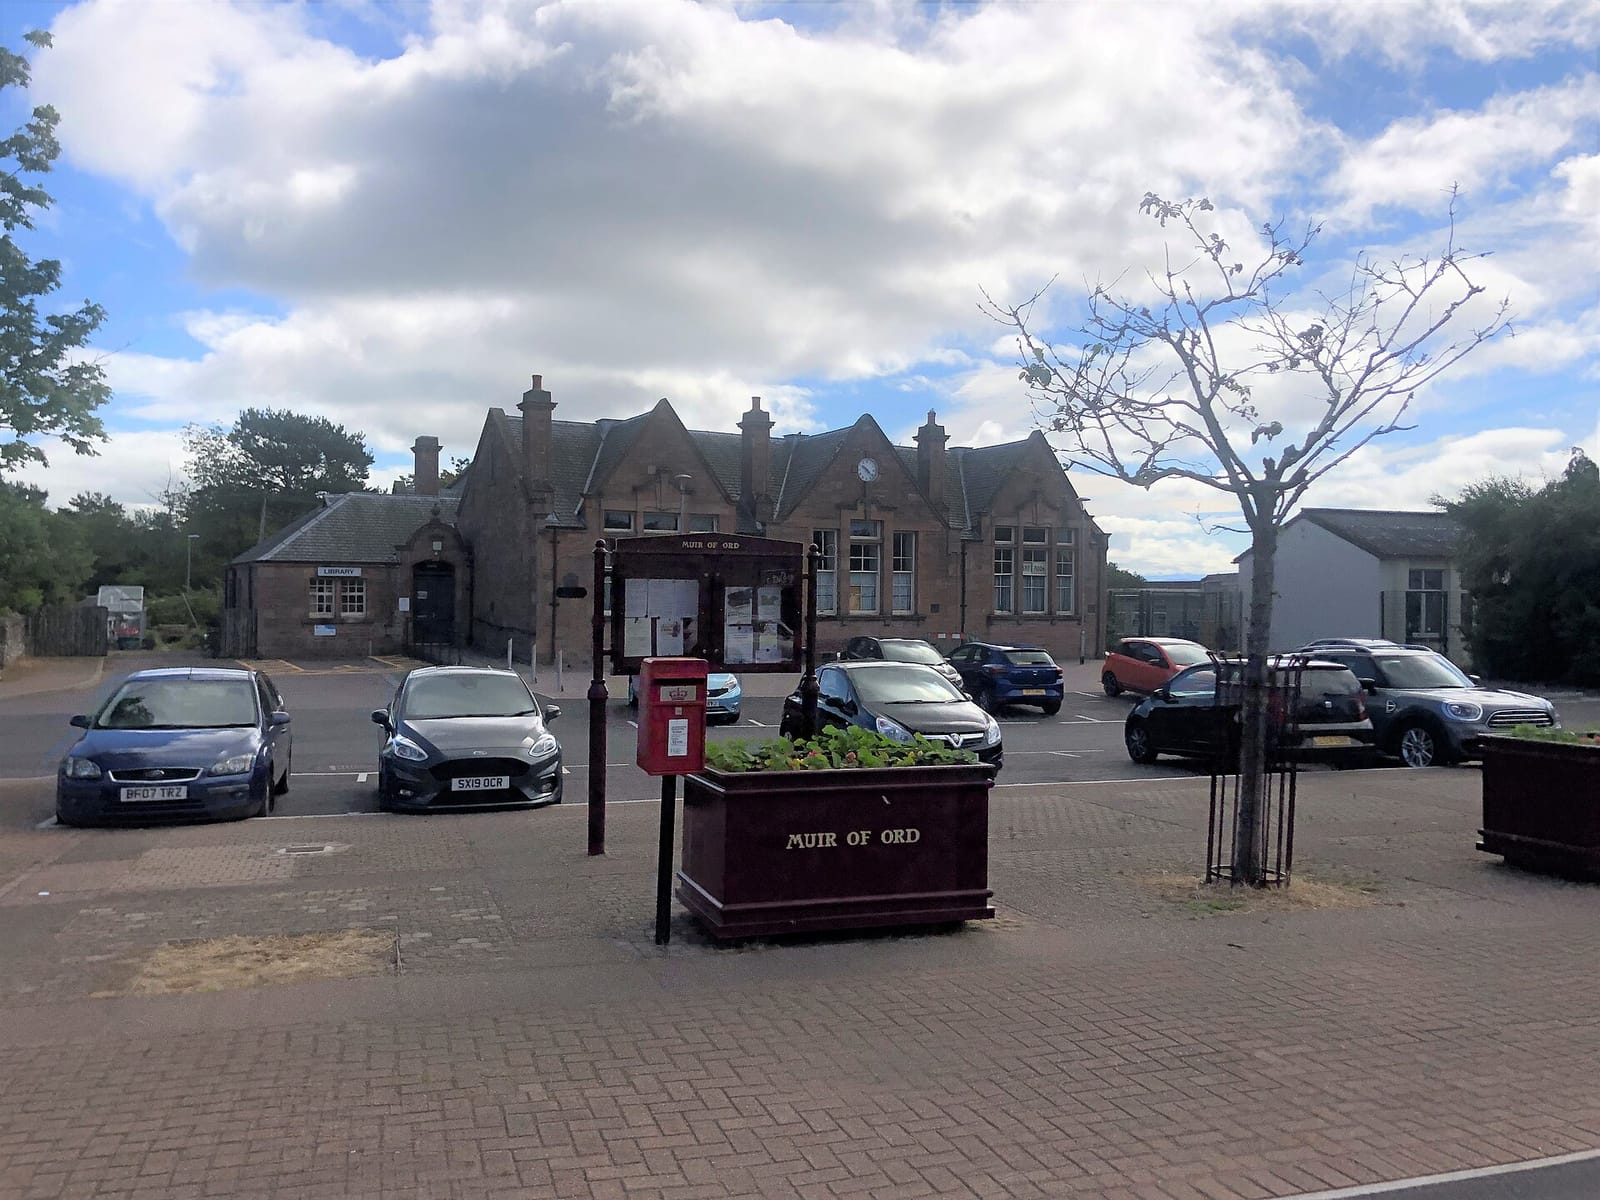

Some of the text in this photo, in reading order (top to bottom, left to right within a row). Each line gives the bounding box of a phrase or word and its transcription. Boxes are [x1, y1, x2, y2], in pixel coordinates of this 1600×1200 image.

[682, 541, 704, 549] MUIR
[707, 541, 718, 549] OF
[458, 778, 481, 789] SX19
[126, 787, 182, 799] BF07 TRZ
[786, 828, 920, 850] MUIR OF ORD
